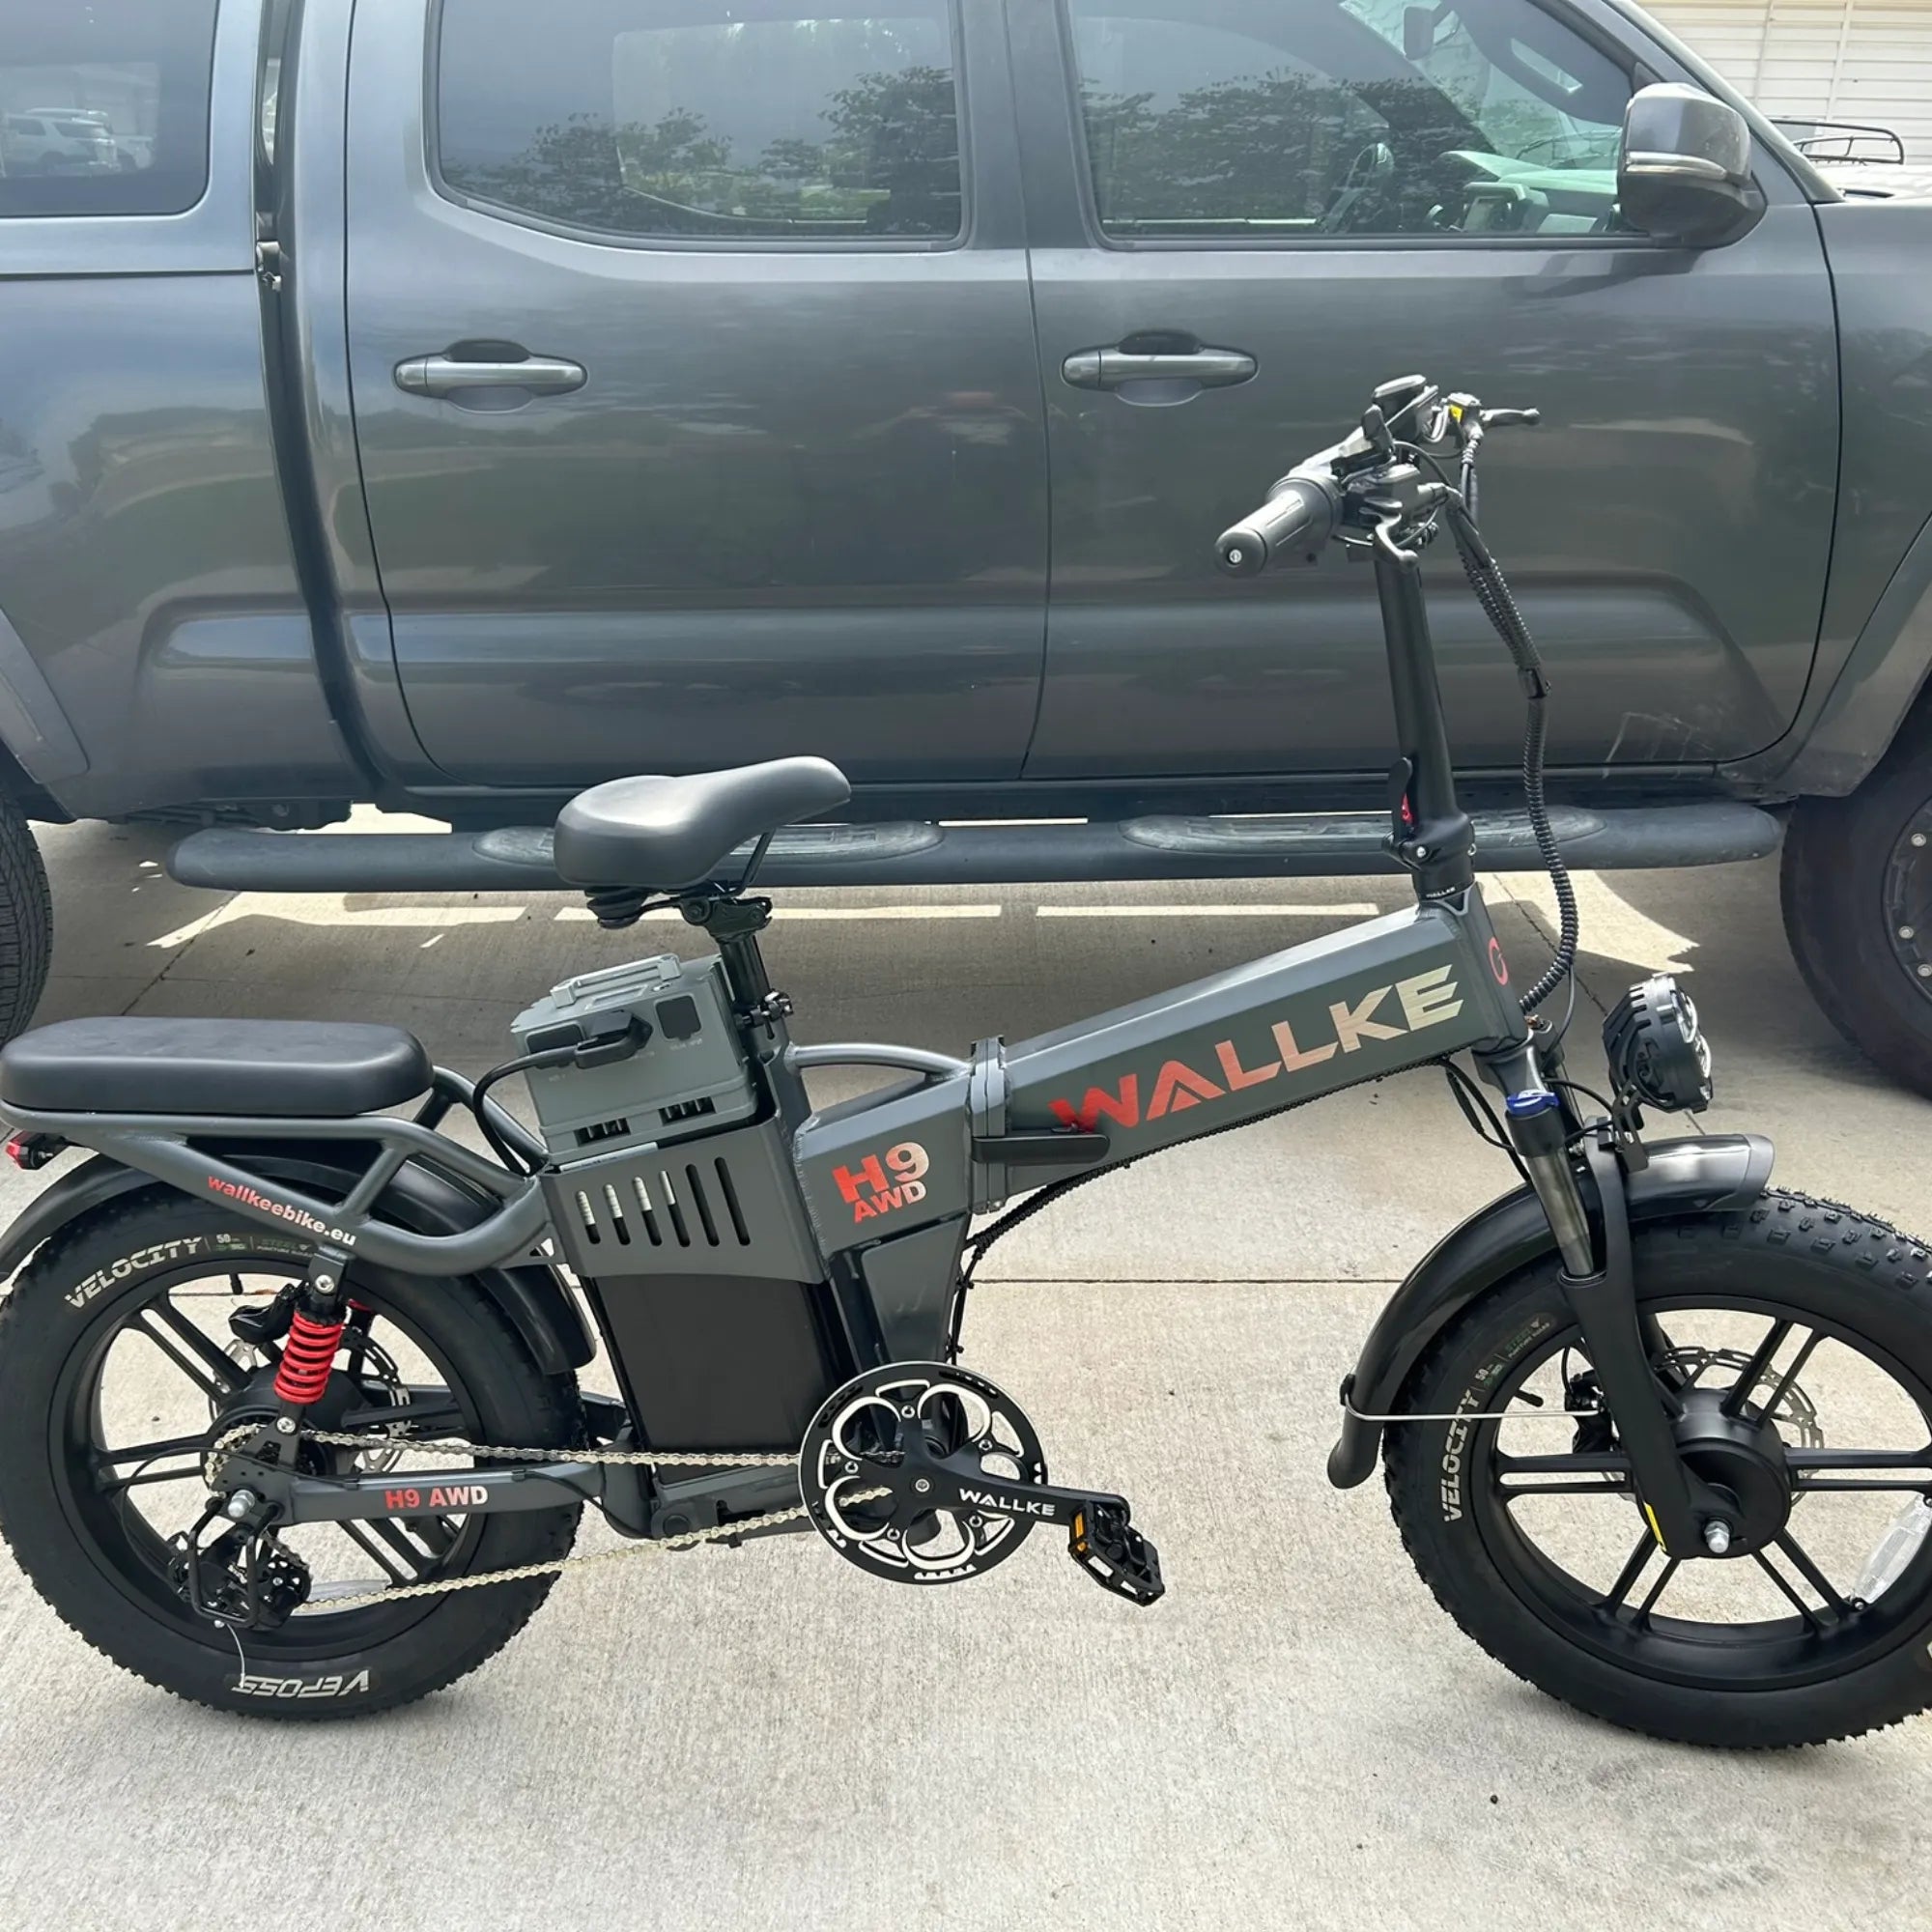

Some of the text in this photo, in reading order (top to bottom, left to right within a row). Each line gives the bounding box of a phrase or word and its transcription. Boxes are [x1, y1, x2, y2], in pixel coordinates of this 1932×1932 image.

[1048, 964, 1464, 1131] WALLKE
[833, 1141, 930, 1205] H9
[854, 1179, 927, 1224] AWD
[208, 1176, 357, 1247] wallkeebike.eu
[65, 1236, 203, 1309] VELOCITY
[1440, 1388, 1479, 1522] VELOCITY
[384, 1486, 489, 1509] H9 AWD
[959, 1488, 1056, 1517] WALLKE
